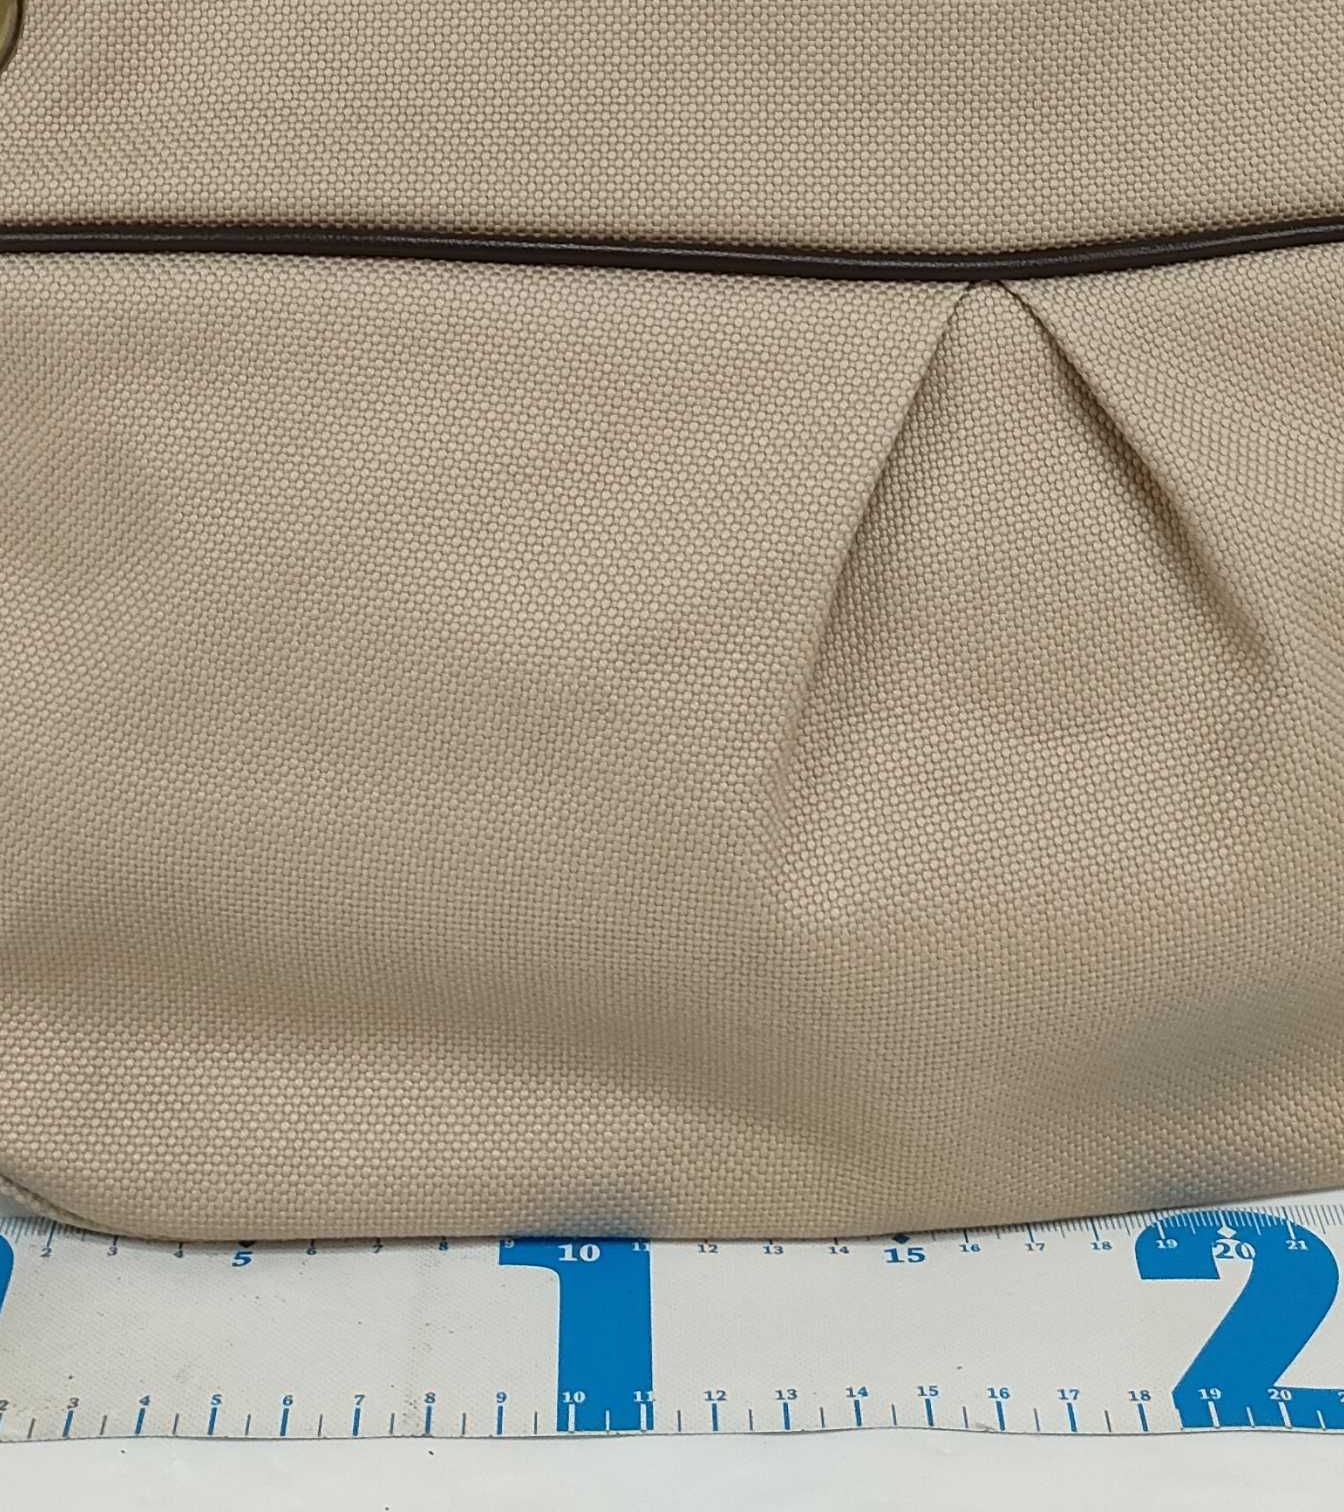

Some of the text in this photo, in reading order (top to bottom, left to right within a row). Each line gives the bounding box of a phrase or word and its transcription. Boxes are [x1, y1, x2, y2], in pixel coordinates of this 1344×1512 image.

[41, 1248, 52, 1257] 2
[107, 1247, 117, 1256] 3
[232, 1252, 252, 1267] 5
[307, 1246, 316, 1255] 6
[438, 1242, 448, 1251] 8
[505, 1239, 514, 1248] 9
[559, 1245, 600, 1261] 10
[633, 1242, 650, 1251] 11
[698, 1245, 718, 1253] 12
[763, 1246, 783, 1255] 13
[830, 1246, 848, 1254] 14
[884, 1248, 925, 1263] 15
[961, 1244, 980, 1252] 16
[1025, 1243, 1045, 1251] 17
[1092, 1242, 1112, 1250] 18
[1157, 1240, 1177, 1248] 19
[1212, 1242, 1255, 1259] 20
[1287, 1241, 1307, 1250] 21
[498, 1238, 653, 1432] 1
[69, 1397, 79, 1408] 3
[139, 1395, 150, 1406] 4
[211, 1394, 222, 1405] 5
[282, 1394, 293, 1405] 6
[354, 1395, 366, 1406] 7
[425, 1392, 436, 1404] 8
[497, 1391, 507, 1404] 9
[563, 1391, 585, 1403] 10
[634, 1390, 653, 1402] 11
[704, 1390, 726, 1401] 12
[775, 1389, 798, 1401] 13
[846, 1386, 868, 1398] 14
[917, 1385, 939, 1397] 15
[987, 1387, 1010, 1400] 16
[1057, 1389, 1080, 1400] 17
[1128, 1389, 1151, 1401] 18
[1199, 1388, 1221, 1400] 19
[1268, 1389, 1292, 1400] 20
